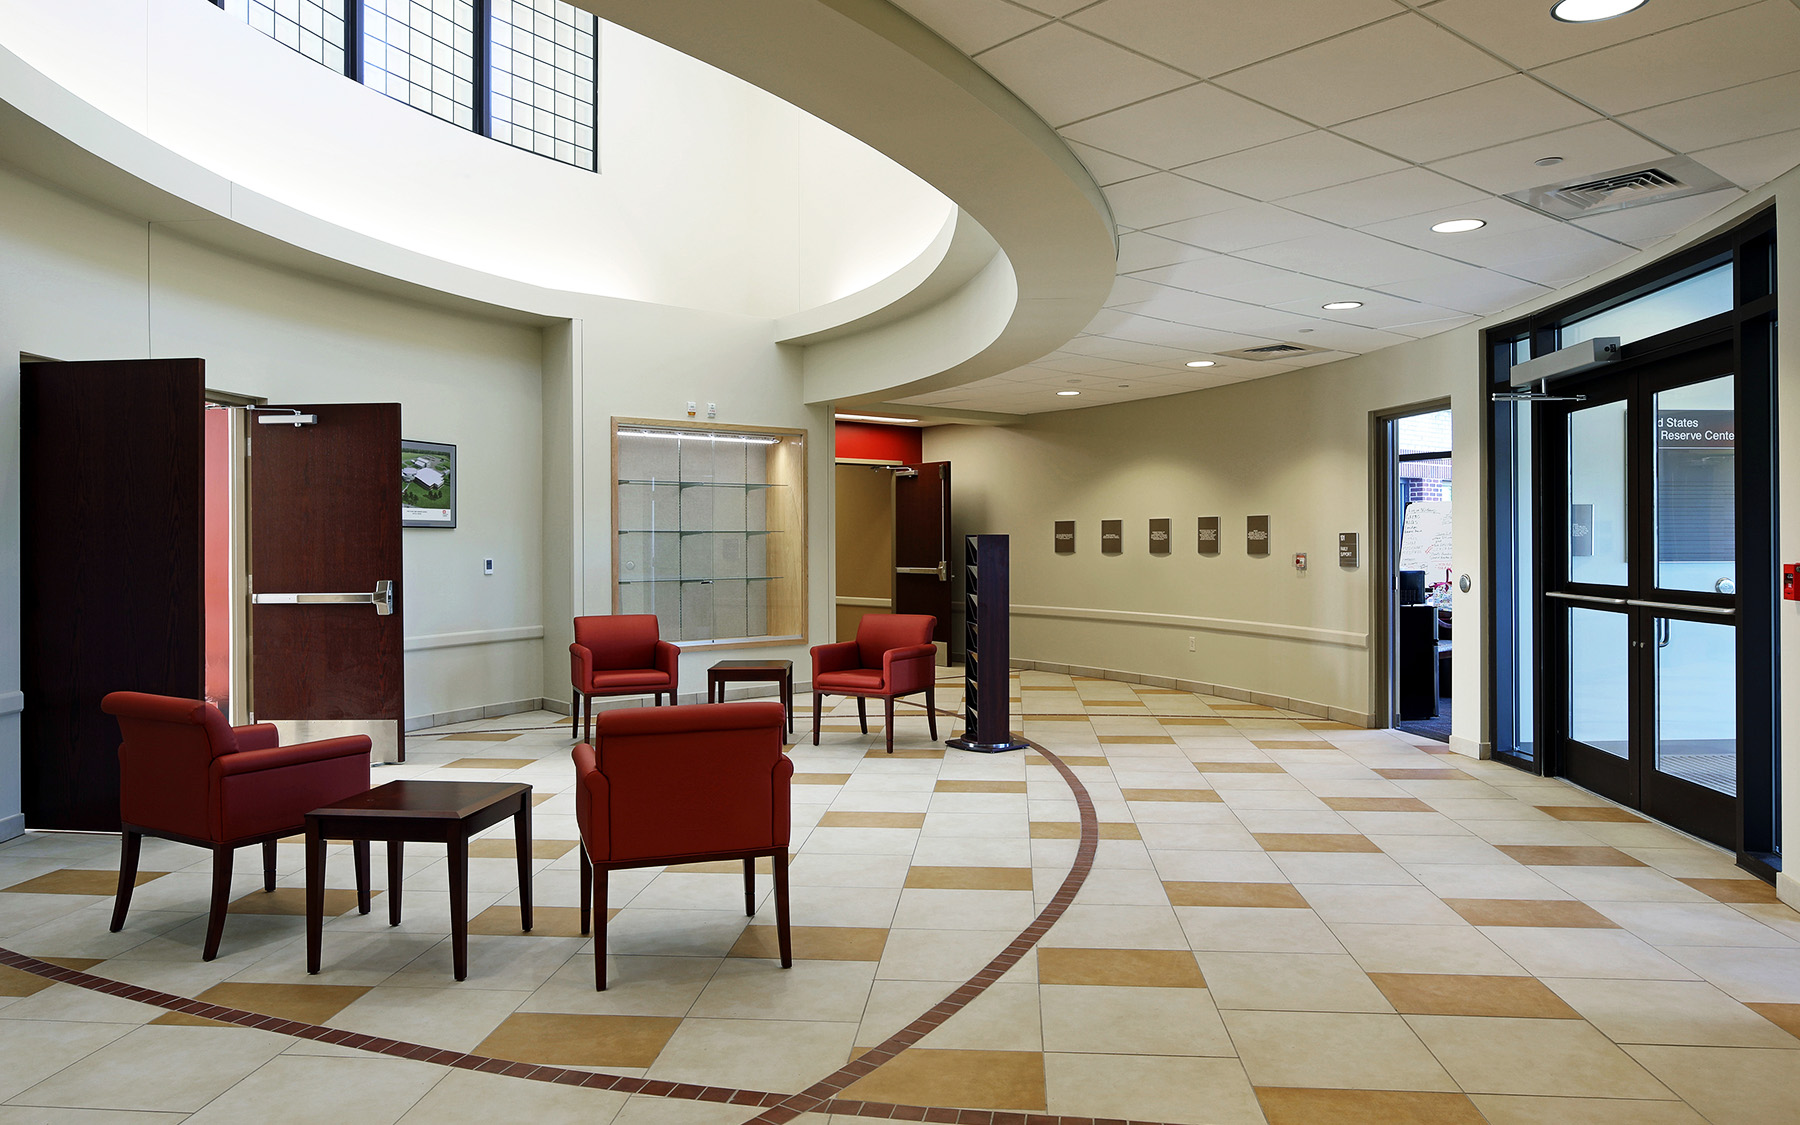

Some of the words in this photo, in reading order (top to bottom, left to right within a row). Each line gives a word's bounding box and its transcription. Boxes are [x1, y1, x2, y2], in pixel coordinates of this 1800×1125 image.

[1666, 417, 1699, 428] States
[1660, 430, 1702, 440] Reserve
[1704, 430, 1735, 440] Cente
